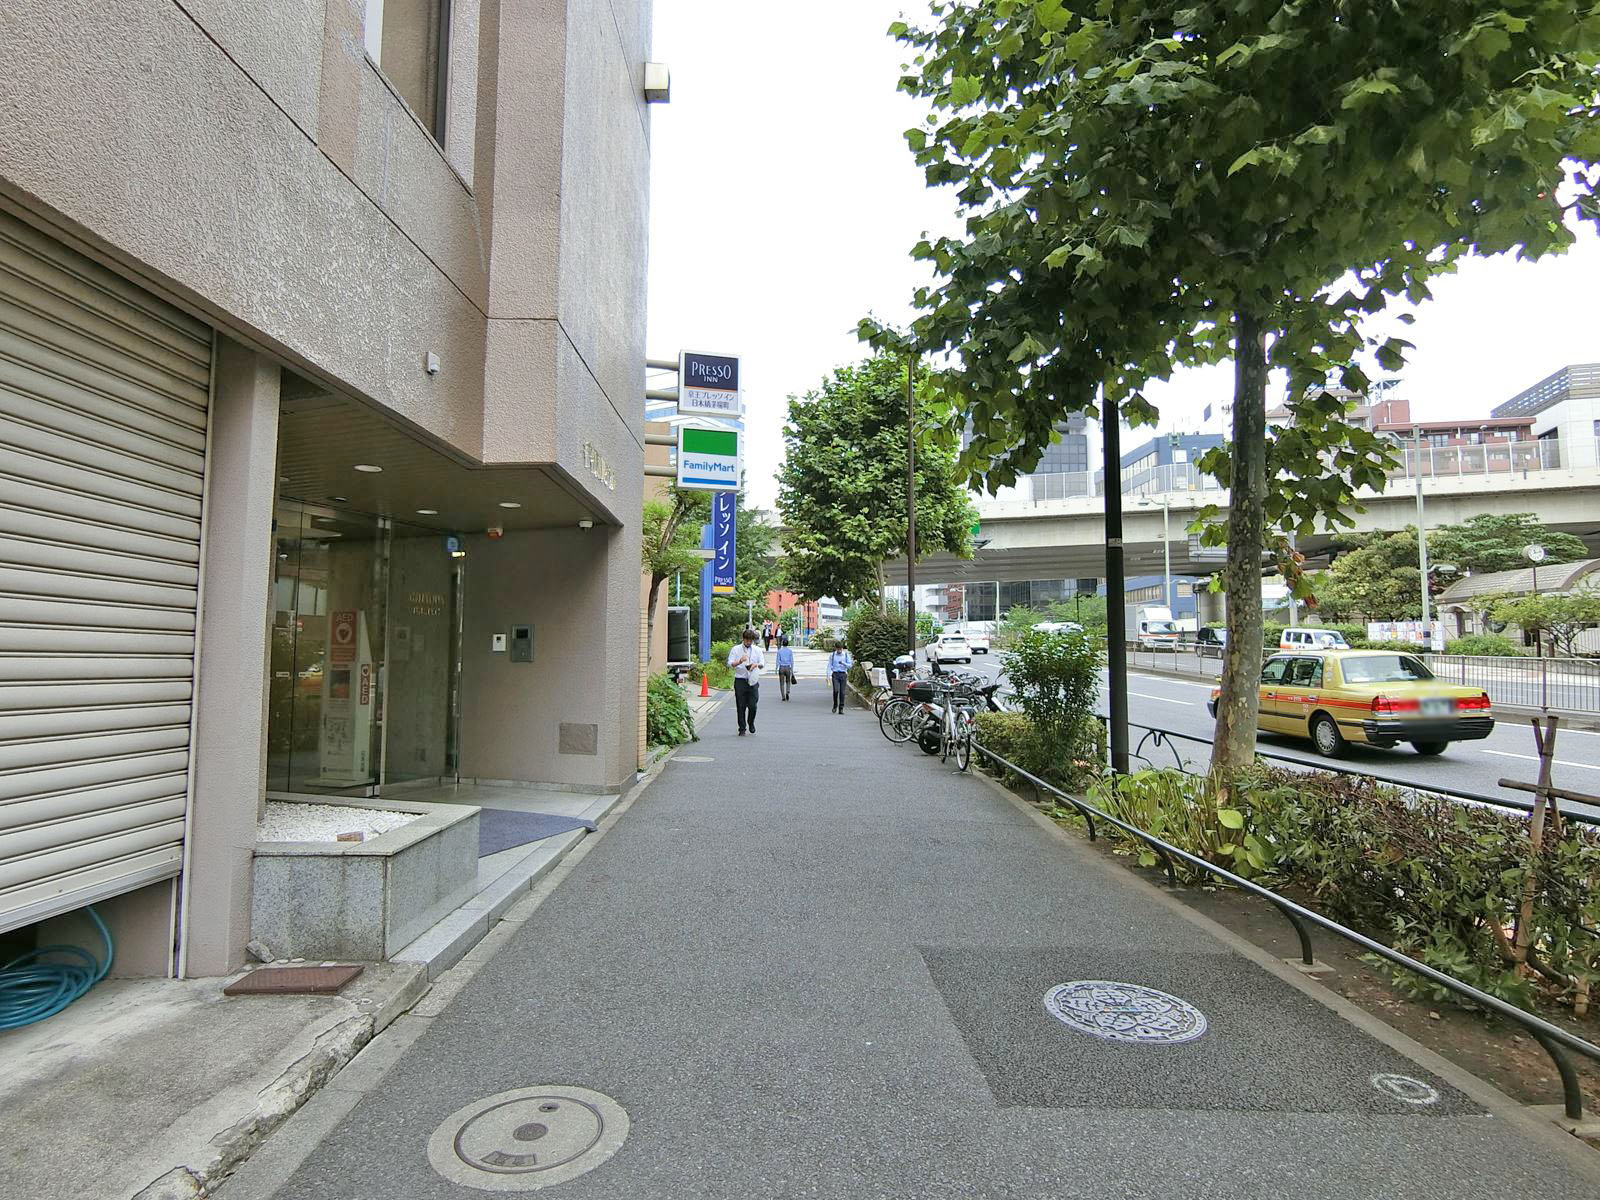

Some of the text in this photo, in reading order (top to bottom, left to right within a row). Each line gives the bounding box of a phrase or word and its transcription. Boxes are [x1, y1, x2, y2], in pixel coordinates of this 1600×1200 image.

[691, 361, 732, 380] PRESSO
[703, 375, 719, 383] INN
[683, 459, 735, 473] FamilyMart
[718, 492, 731, 570] レッソイン
